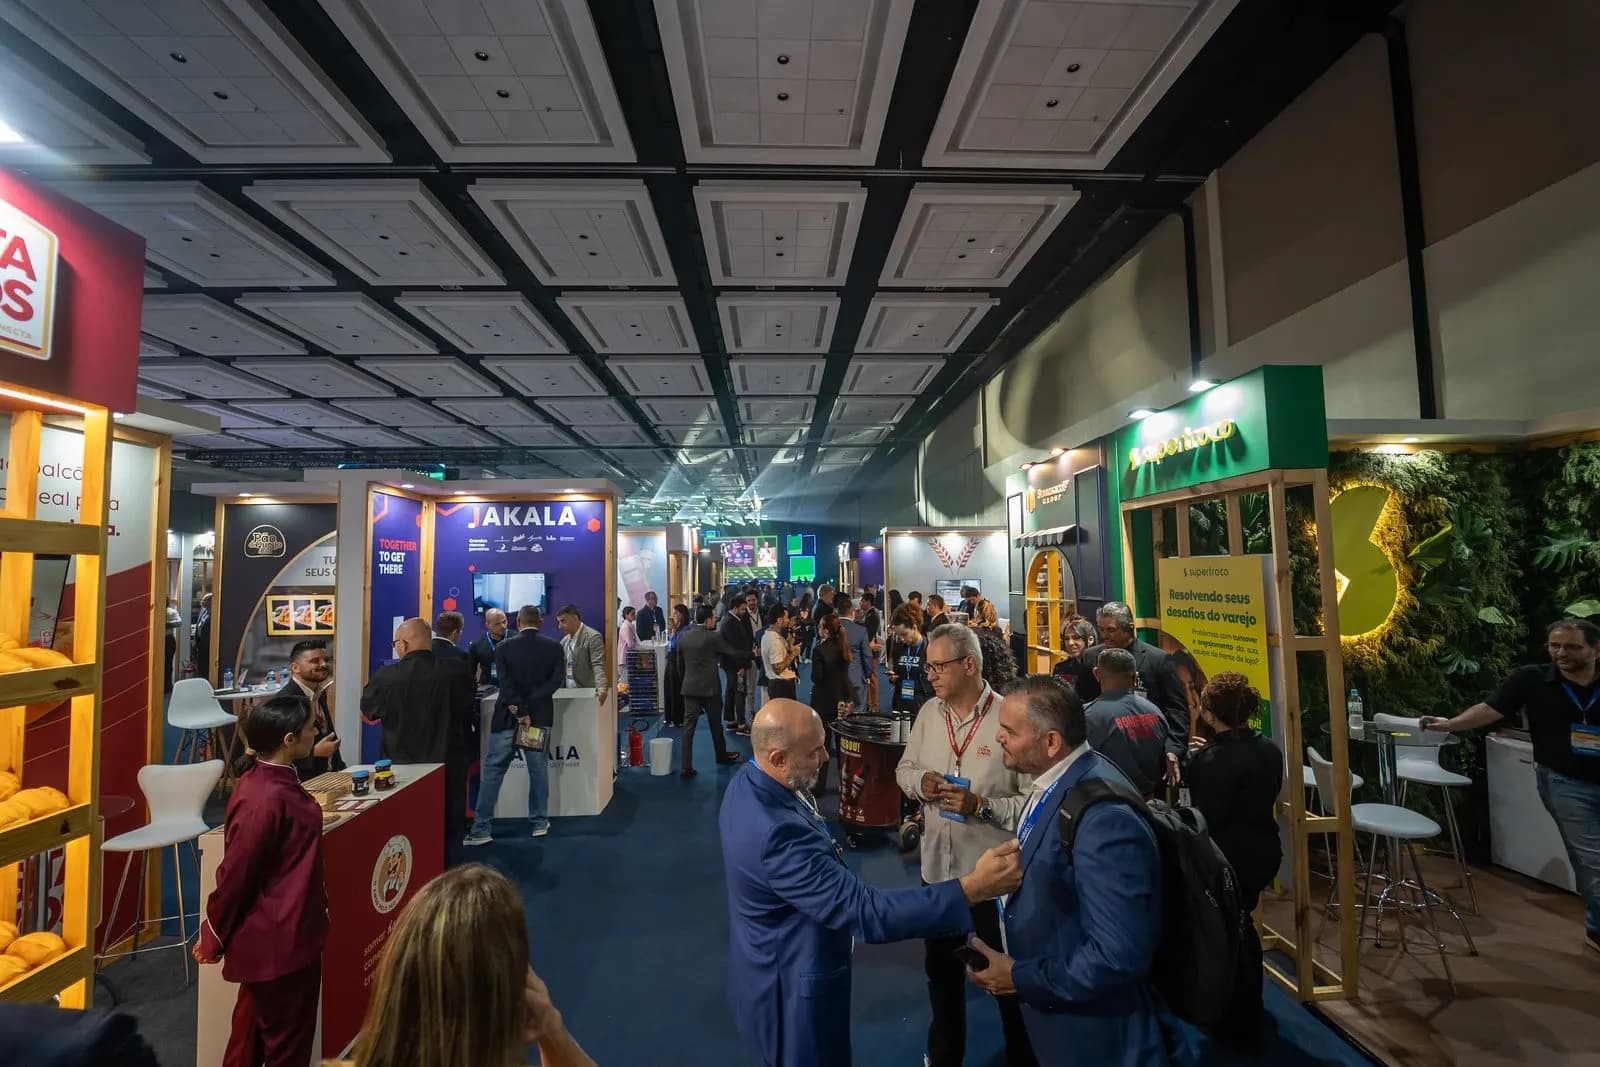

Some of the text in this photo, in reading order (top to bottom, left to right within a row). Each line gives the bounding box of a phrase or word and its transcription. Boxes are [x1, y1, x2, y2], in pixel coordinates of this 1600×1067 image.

[0, 228, 37, 282] A
[0, 278, 34, 322] S
[467, 505, 577, 528] JAKALA
[379, 538, 417, 551] TOGETHER
[379, 551, 405, 562] TO GET
[305, 568, 331, 577] SEUS
[379, 563, 404, 575] THERE
[1189, 567, 1229, 578] supertroco
[1169, 589, 1250, 604] Resolvendo seus
[1166, 606, 1257, 628] desafios do varejo
